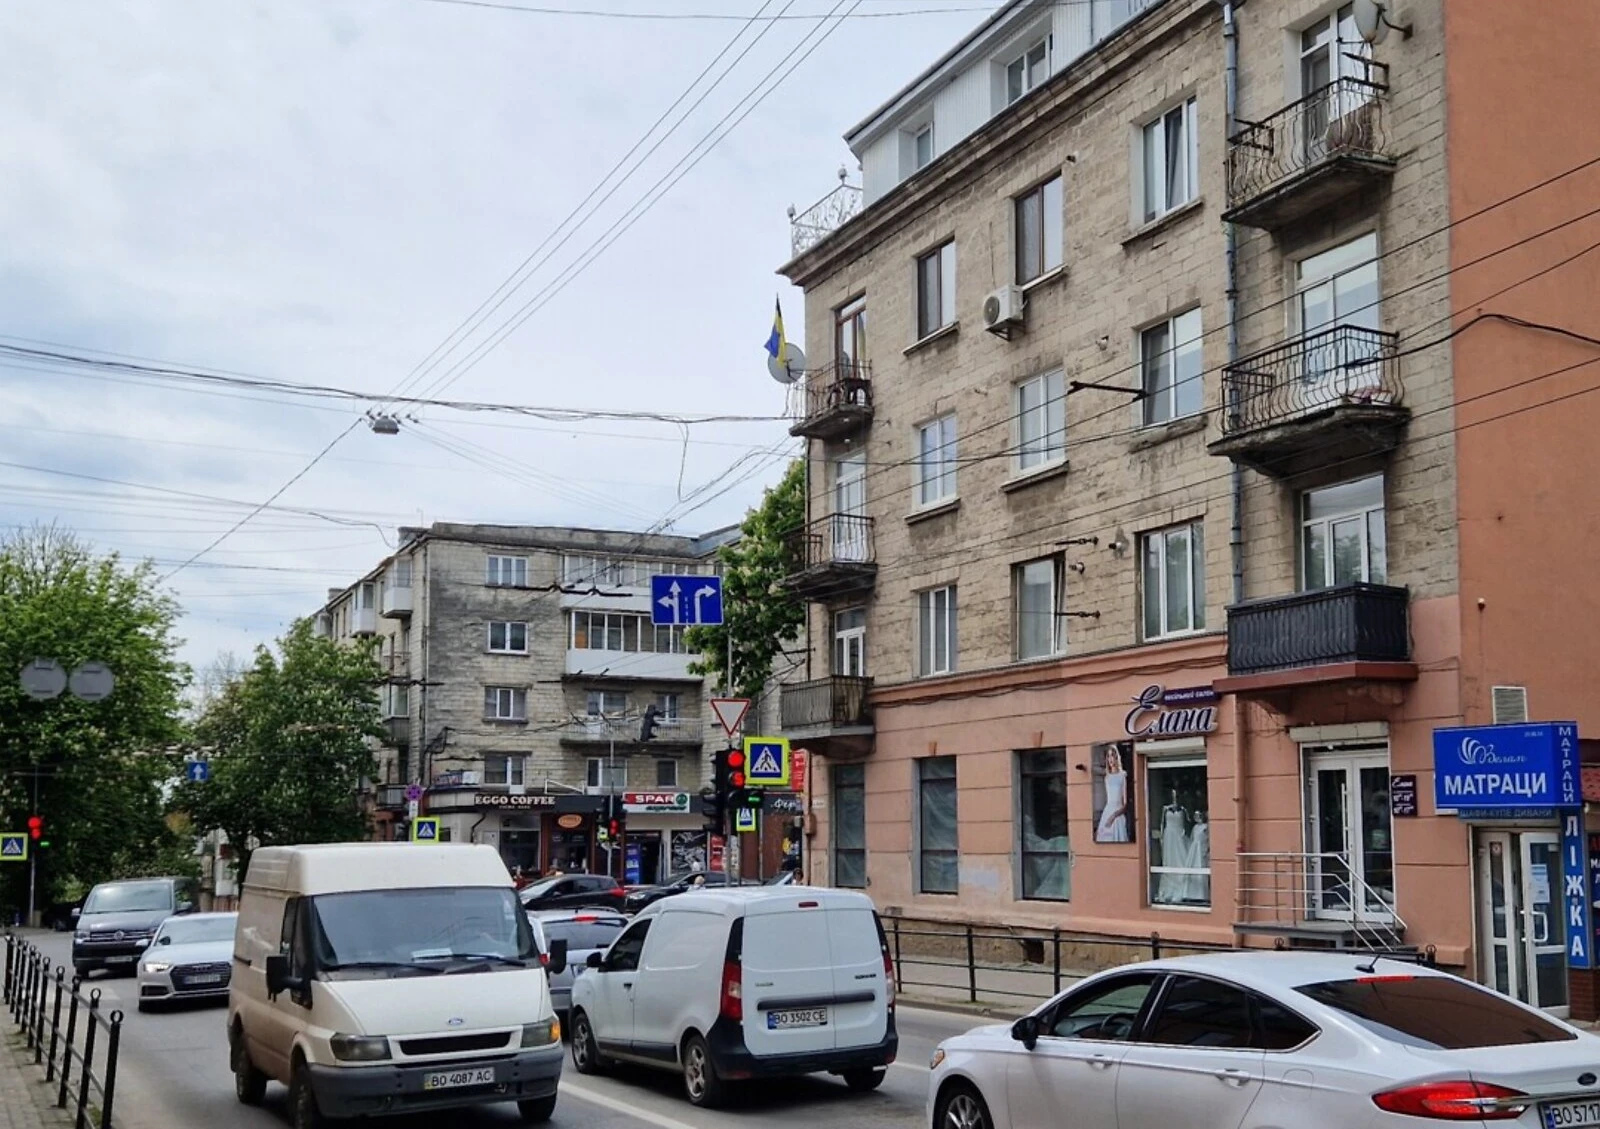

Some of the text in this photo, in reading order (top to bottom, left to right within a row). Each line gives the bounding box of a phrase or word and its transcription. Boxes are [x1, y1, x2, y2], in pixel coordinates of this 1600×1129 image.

[1559, 727, 1575, 802] МАТРАЦИ
[1444, 773, 1547, 797] МАТРАЦИ
[475, 796, 556, 805] EGGO COFFEE
[635, 794, 674, 804] SPAR
[1514, 808, 1552, 819] ДИВАНИ
[1565, 815, 1585, 957] ЛІЖКА
[450, 1072, 473, 1085] 4087
